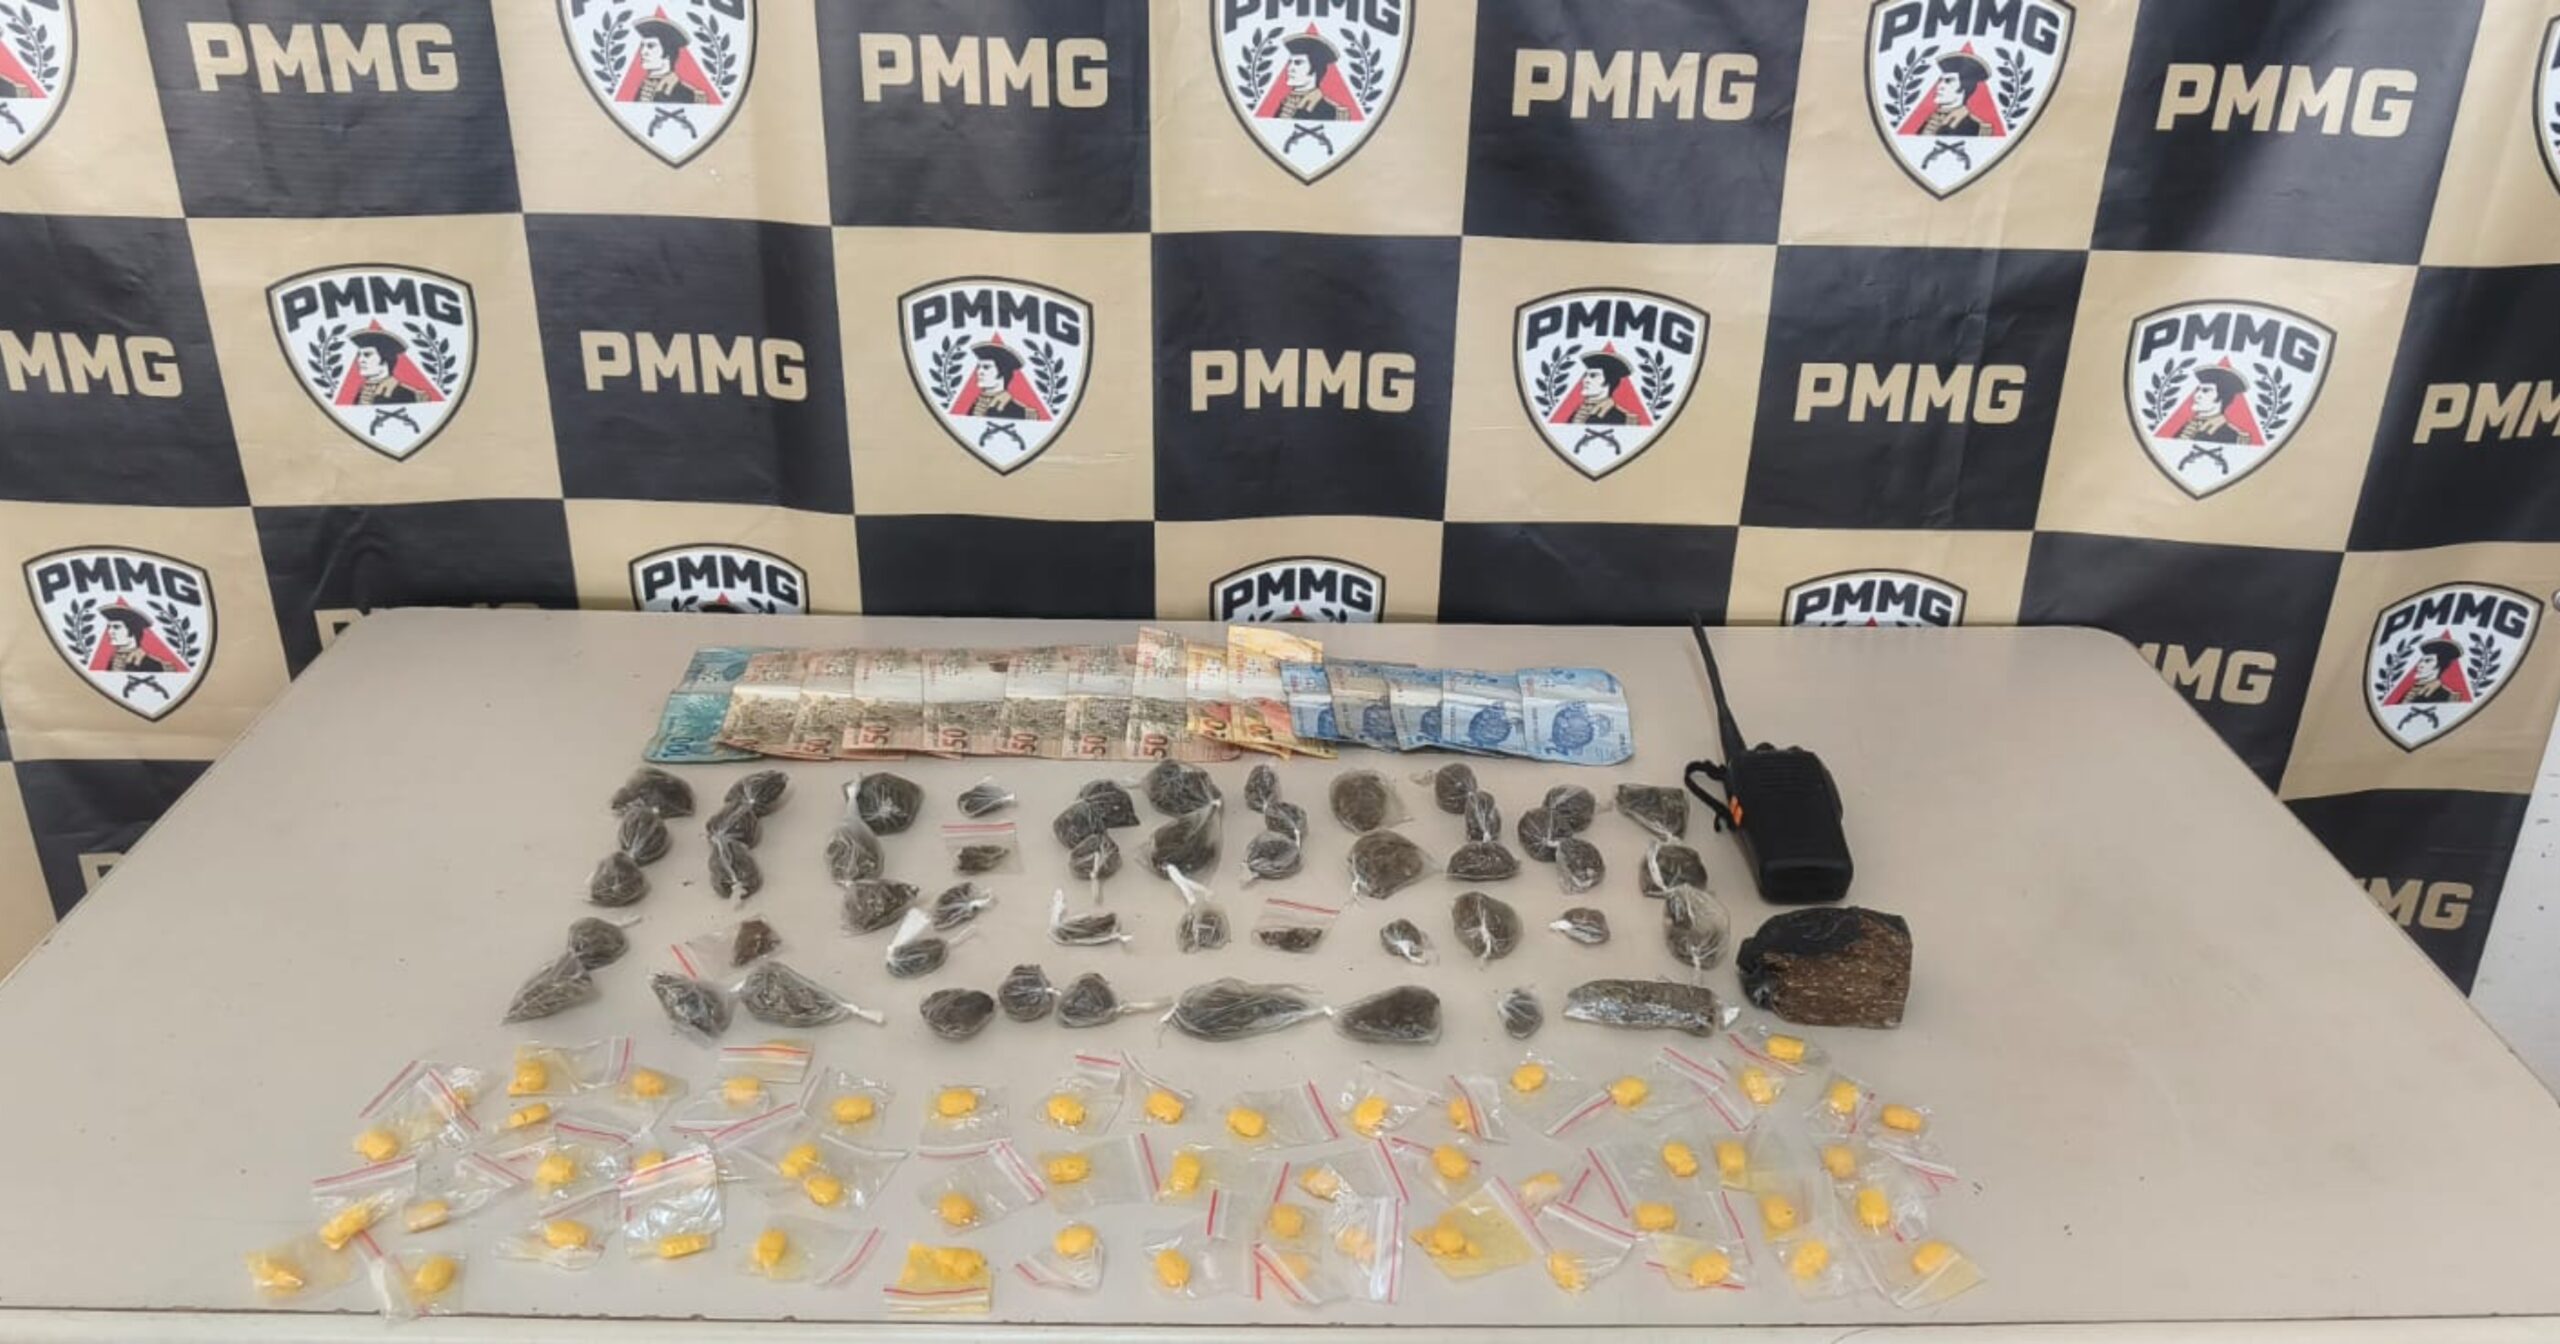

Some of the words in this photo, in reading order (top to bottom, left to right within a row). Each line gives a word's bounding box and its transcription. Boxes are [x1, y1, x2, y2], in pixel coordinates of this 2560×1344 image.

[1878, 0, 2060, 56] PMMG
[186, 22, 459, 93] PMMG
[859, 32, 1109, 108] PMMG
[1512, 48, 1758, 121] PMMG
[2155, 63, 2418, 138] PMMG
[282, 276, 464, 333] PMMG
[912, 289, 1081, 346] PMMG
[1526, 299, 1694, 355] PMMG
[0, 330, 183, 398] MMG
[580, 330, 808, 402] PMMG
[2138, 312, 2320, 374] PMMG
[1190, 348, 1416, 412] PMMG
[1793, 362, 2027, 424] PMMG
[37, 557, 202, 607] PMMG
[642, 554, 799, 607] PMMG
[1222, 567, 1374, 621] PMMG
[1793, 579, 1953, 626] PMMG
[2380, 592, 2529, 646] PMMG
[1143, 733, 1168, 758] 50
[2354, 877, 2474, 930] MG
